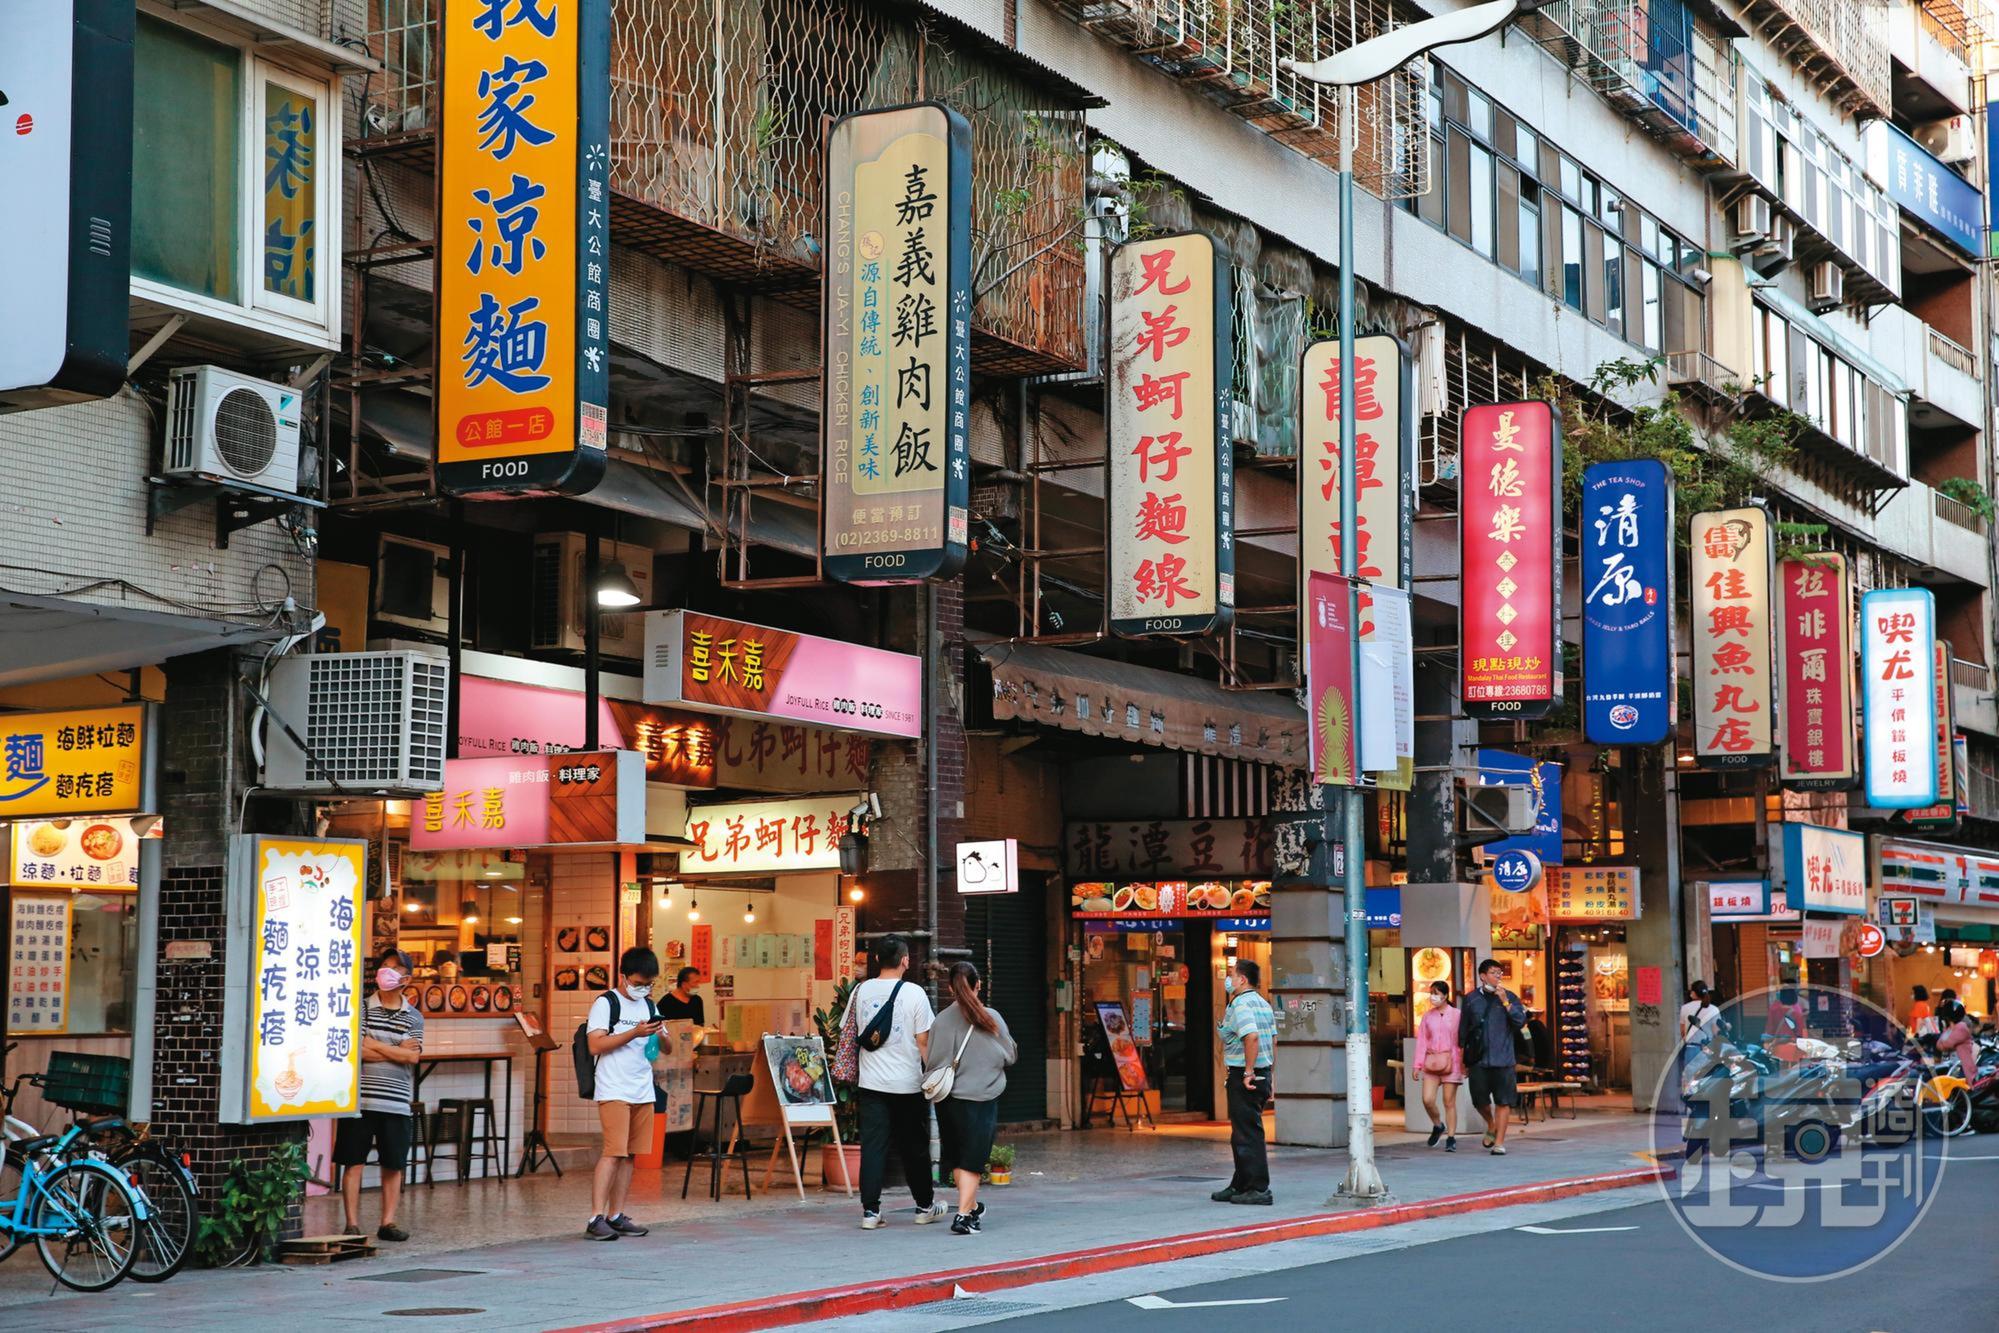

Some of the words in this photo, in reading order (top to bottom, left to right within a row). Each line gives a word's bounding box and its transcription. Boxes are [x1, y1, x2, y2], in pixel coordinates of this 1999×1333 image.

[586, 179, 605, 340] 臺大公館商圈
[836, 286, 849, 337] JA-YI
[890, 163, 938, 478] 嘉義雞肉飯
[835, 351, 849, 426] CHICKEN
[858, 261, 882, 481] 源自傳統、創新美味
[954, 319, 966, 452] 臺大公館商圈
[465, 414, 545, 442] 公館一店
[1131, 249, 1200, 608] 兄弟蚵仔麵線
[482, 461, 529, 479] FOOD
[835, 439, 848, 484] RICE
[1221, 413, 1230, 527] 臺大公館商圈
[1488, 411, 1526, 543] 曼德樂
[1592, 480, 1607, 491] THE
[1609, 476, 1624, 484] TEA
[1625, 476, 1646, 488] SHOP
[835, 526, 938, 549] (02)2369-8811
[852, 504, 922, 525] 便當預訂
[865, 554, 906, 569] FOOD
[1585, 493, 1643, 606] 清原
[1145, 619, 1182, 631] FOOD
[1625, 622, 1639, 630] TARO
[1639, 611, 1655, 625] BALLS
[1794, 569, 1829, 682] 拉非爾
[690, 629, 764, 691] 喜禾嘉
[1472, 656, 1541, 672] 現點現炒
[1704, 568, 1760, 752] 佳興魚丸店
[1878, 612, 1915, 681] 喫尤
[785, 694, 813, 709] JOYFULL
[885, 711, 901, 720] SINCE
[1491, 702, 1521, 711] FOOD
[1806, 687, 1824, 767] 珠寶銀樓
[57, 722, 135, 751] 海鮮拉麵
[458, 736, 487, 749] OYFULL
[511, 738, 539, 754] 雞肉飯
[645, 721, 713, 768] 喜禾嘉
[1891, 688, 1907, 783] 平價鐵板燒
[1722, 755, 1748, 764] FOOD
[56, 771, 114, 799] 麵疙瘩
[1796, 779, 1836, 788] JEWELRY
[424, 786, 505, 832] 喜禾嘉
[1073, 821, 1273, 875] 龍潭豆花
[1498, 860, 1528, 876] 清原
[1807, 855, 1833, 894] 喫尤
[1713, 896, 1751, 907] 鐵板燒
[260, 918, 289, 1046] 麵疙瘩
[295, 943, 321, 1026] 涼麵
[326, 895, 354, 1063] 海鮮拉麵
